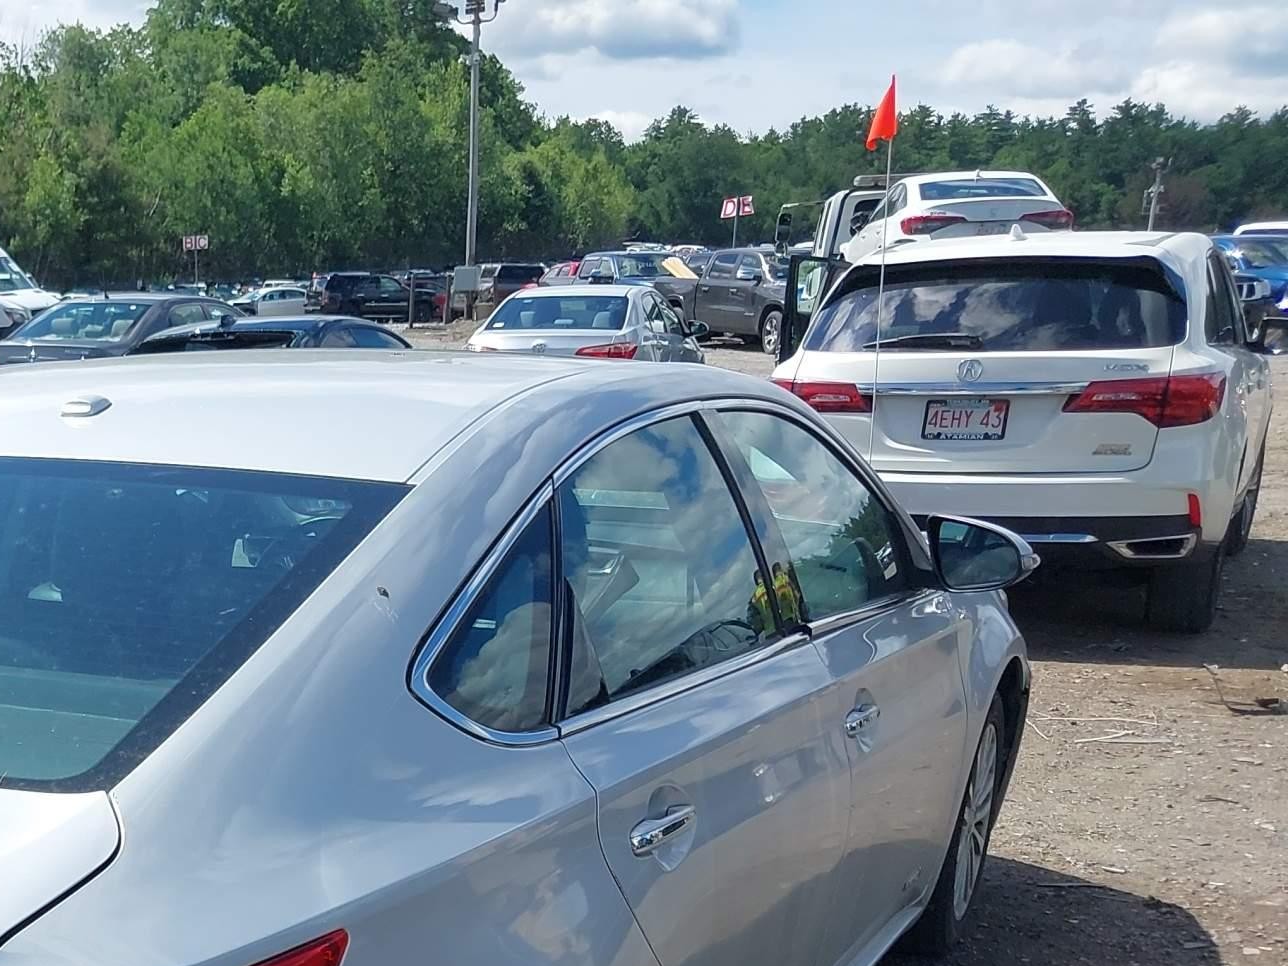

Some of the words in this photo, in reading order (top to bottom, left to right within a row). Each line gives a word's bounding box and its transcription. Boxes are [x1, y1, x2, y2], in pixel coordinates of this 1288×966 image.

[723, 200, 736, 216] D
[742, 197, 753, 214] E
[928, 410, 974, 428] 4EHY
[980, 410, 1002, 428] 43
